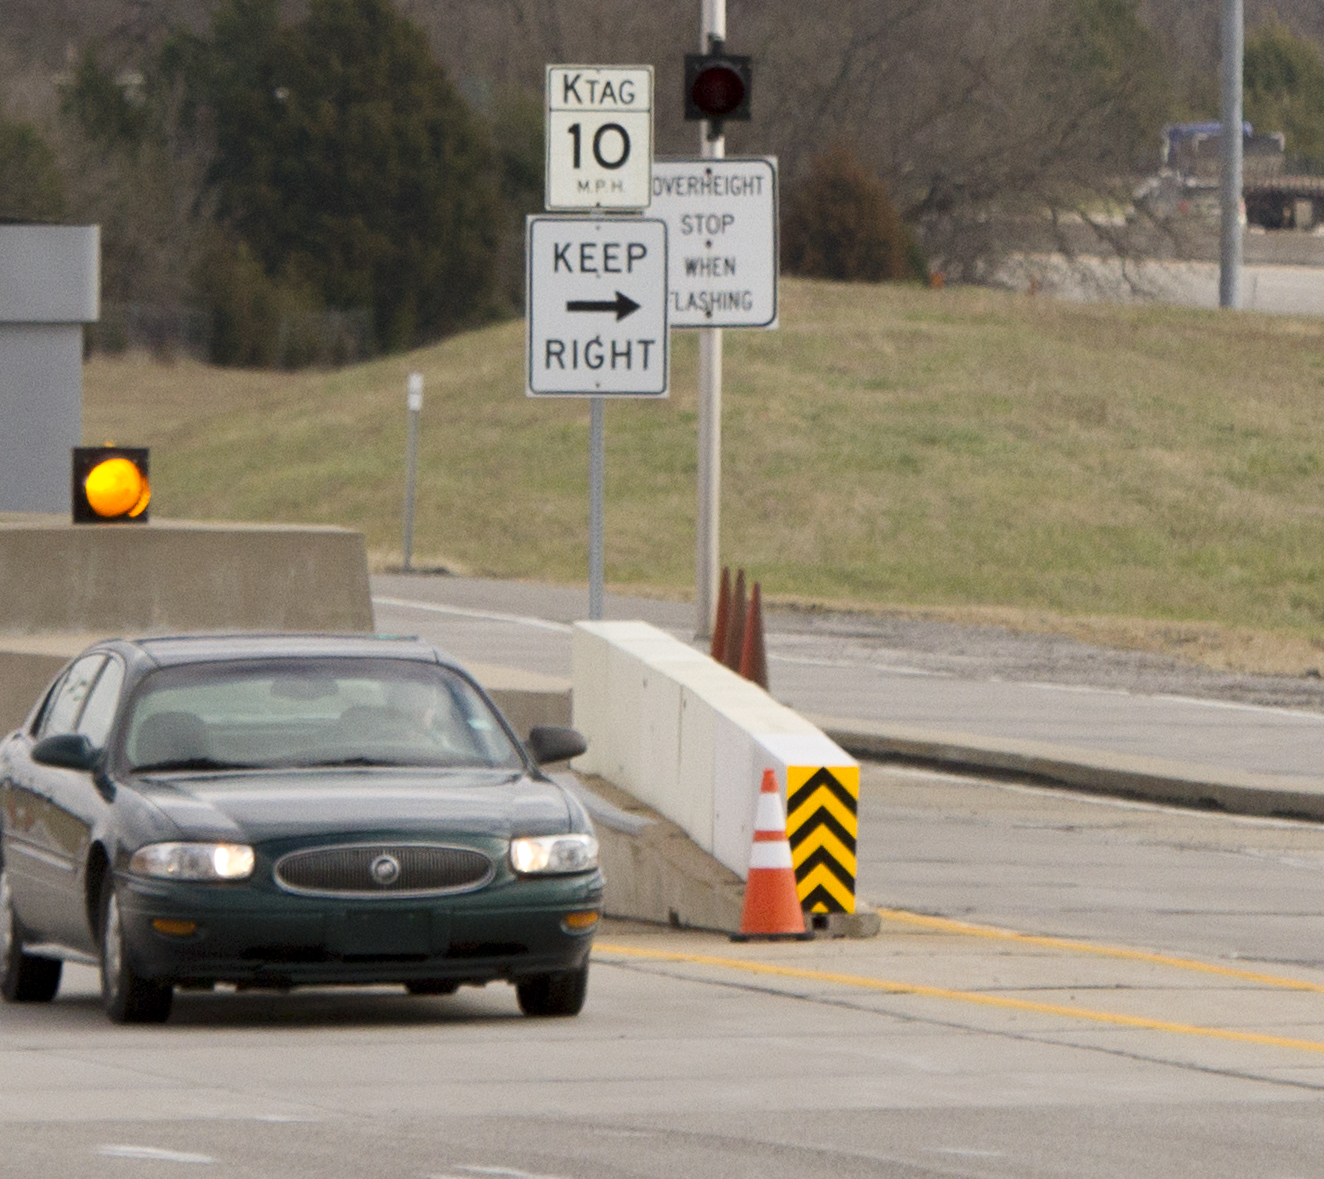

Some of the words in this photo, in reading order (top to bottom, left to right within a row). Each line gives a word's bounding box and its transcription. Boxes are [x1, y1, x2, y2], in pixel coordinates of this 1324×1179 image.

[562, 74, 636, 105] KTAG
[567, 123, 631, 171] 10
[652, 175, 766, 197] OVERHEIGHT
[681, 214, 735, 235] STOP
[553, 242, 648, 273] KEEP
[684, 258, 736, 277] WHEN
[545, 339, 657, 371] RIGHT
